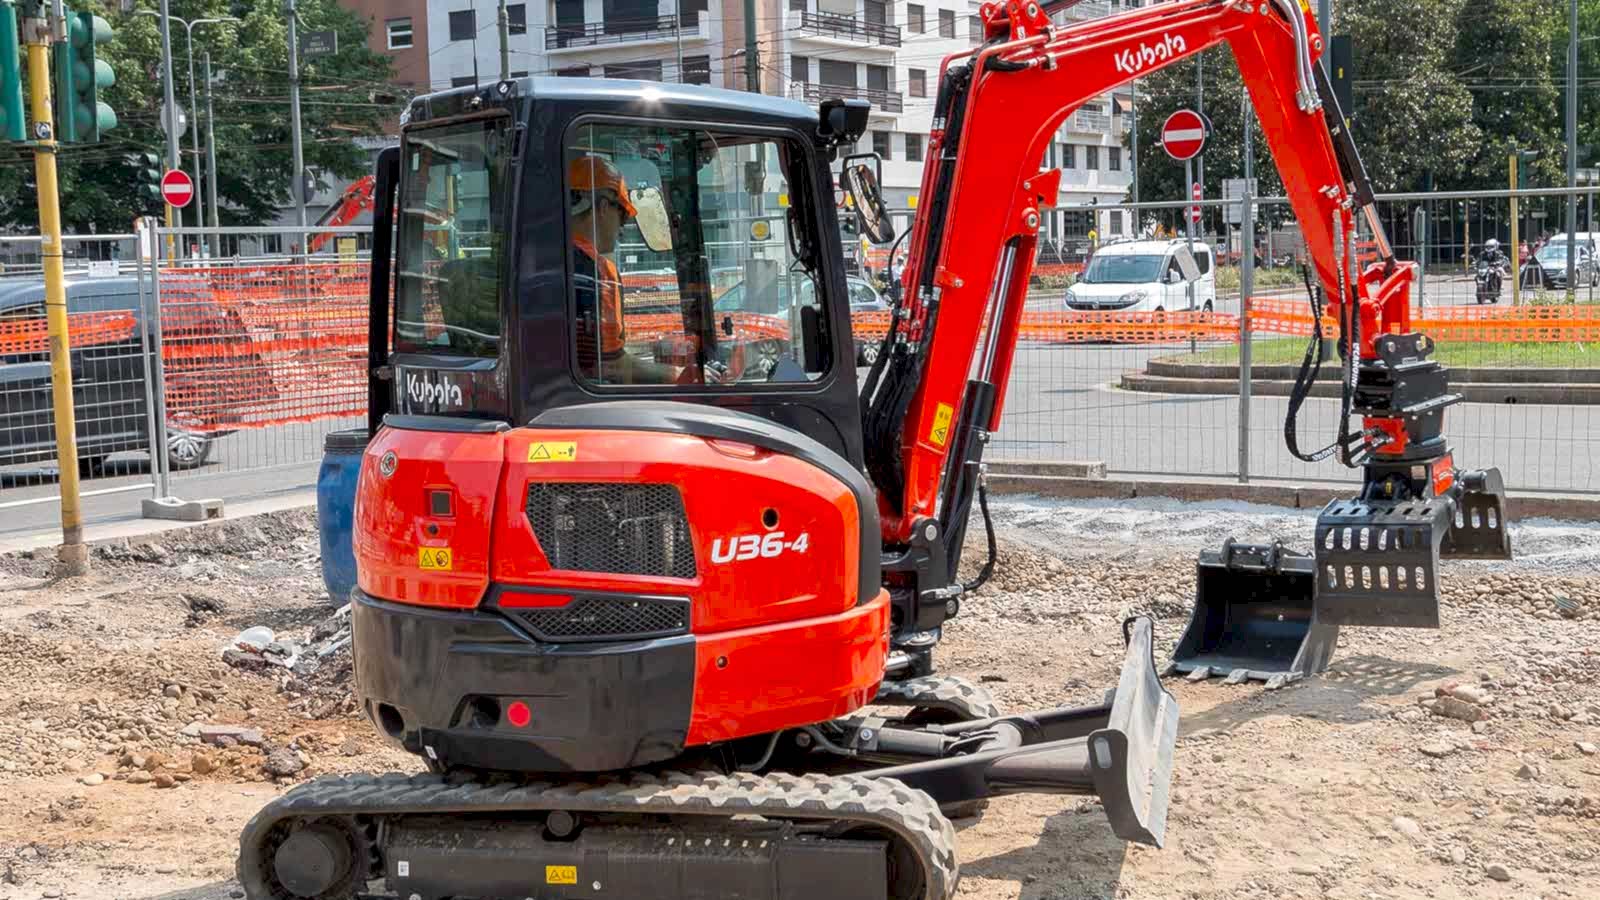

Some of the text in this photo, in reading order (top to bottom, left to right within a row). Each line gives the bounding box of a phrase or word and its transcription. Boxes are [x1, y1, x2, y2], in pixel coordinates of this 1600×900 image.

[1114, 32, 1186, 74] Kubota
[407, 373, 462, 406] Kubota
[711, 531, 808, 564] U36-4
